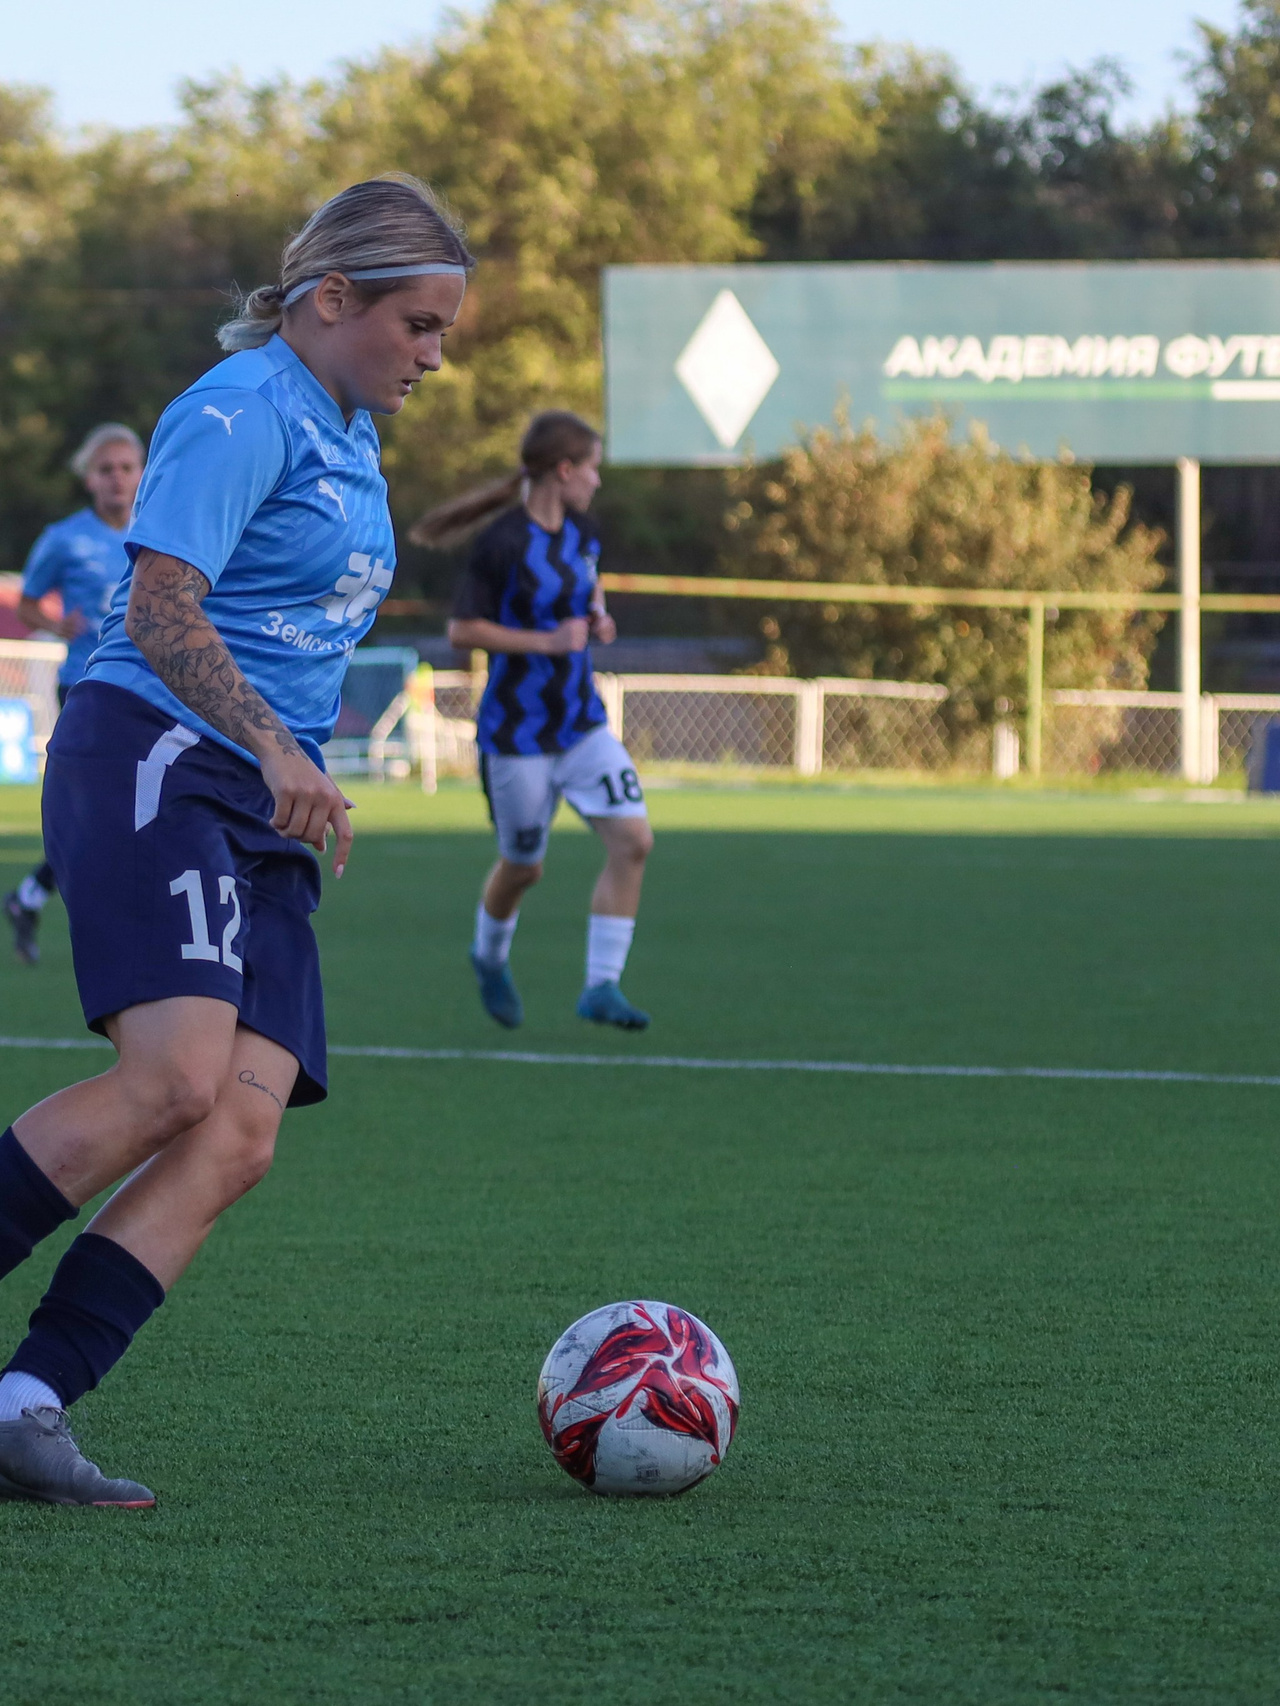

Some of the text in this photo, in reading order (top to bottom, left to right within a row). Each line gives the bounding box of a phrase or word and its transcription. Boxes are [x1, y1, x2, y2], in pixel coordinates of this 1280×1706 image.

[885, 335, 1159, 381] АКАДЕМИЯ
[599, 768, 643, 805] 18
[169, 869, 244, 975] 12
